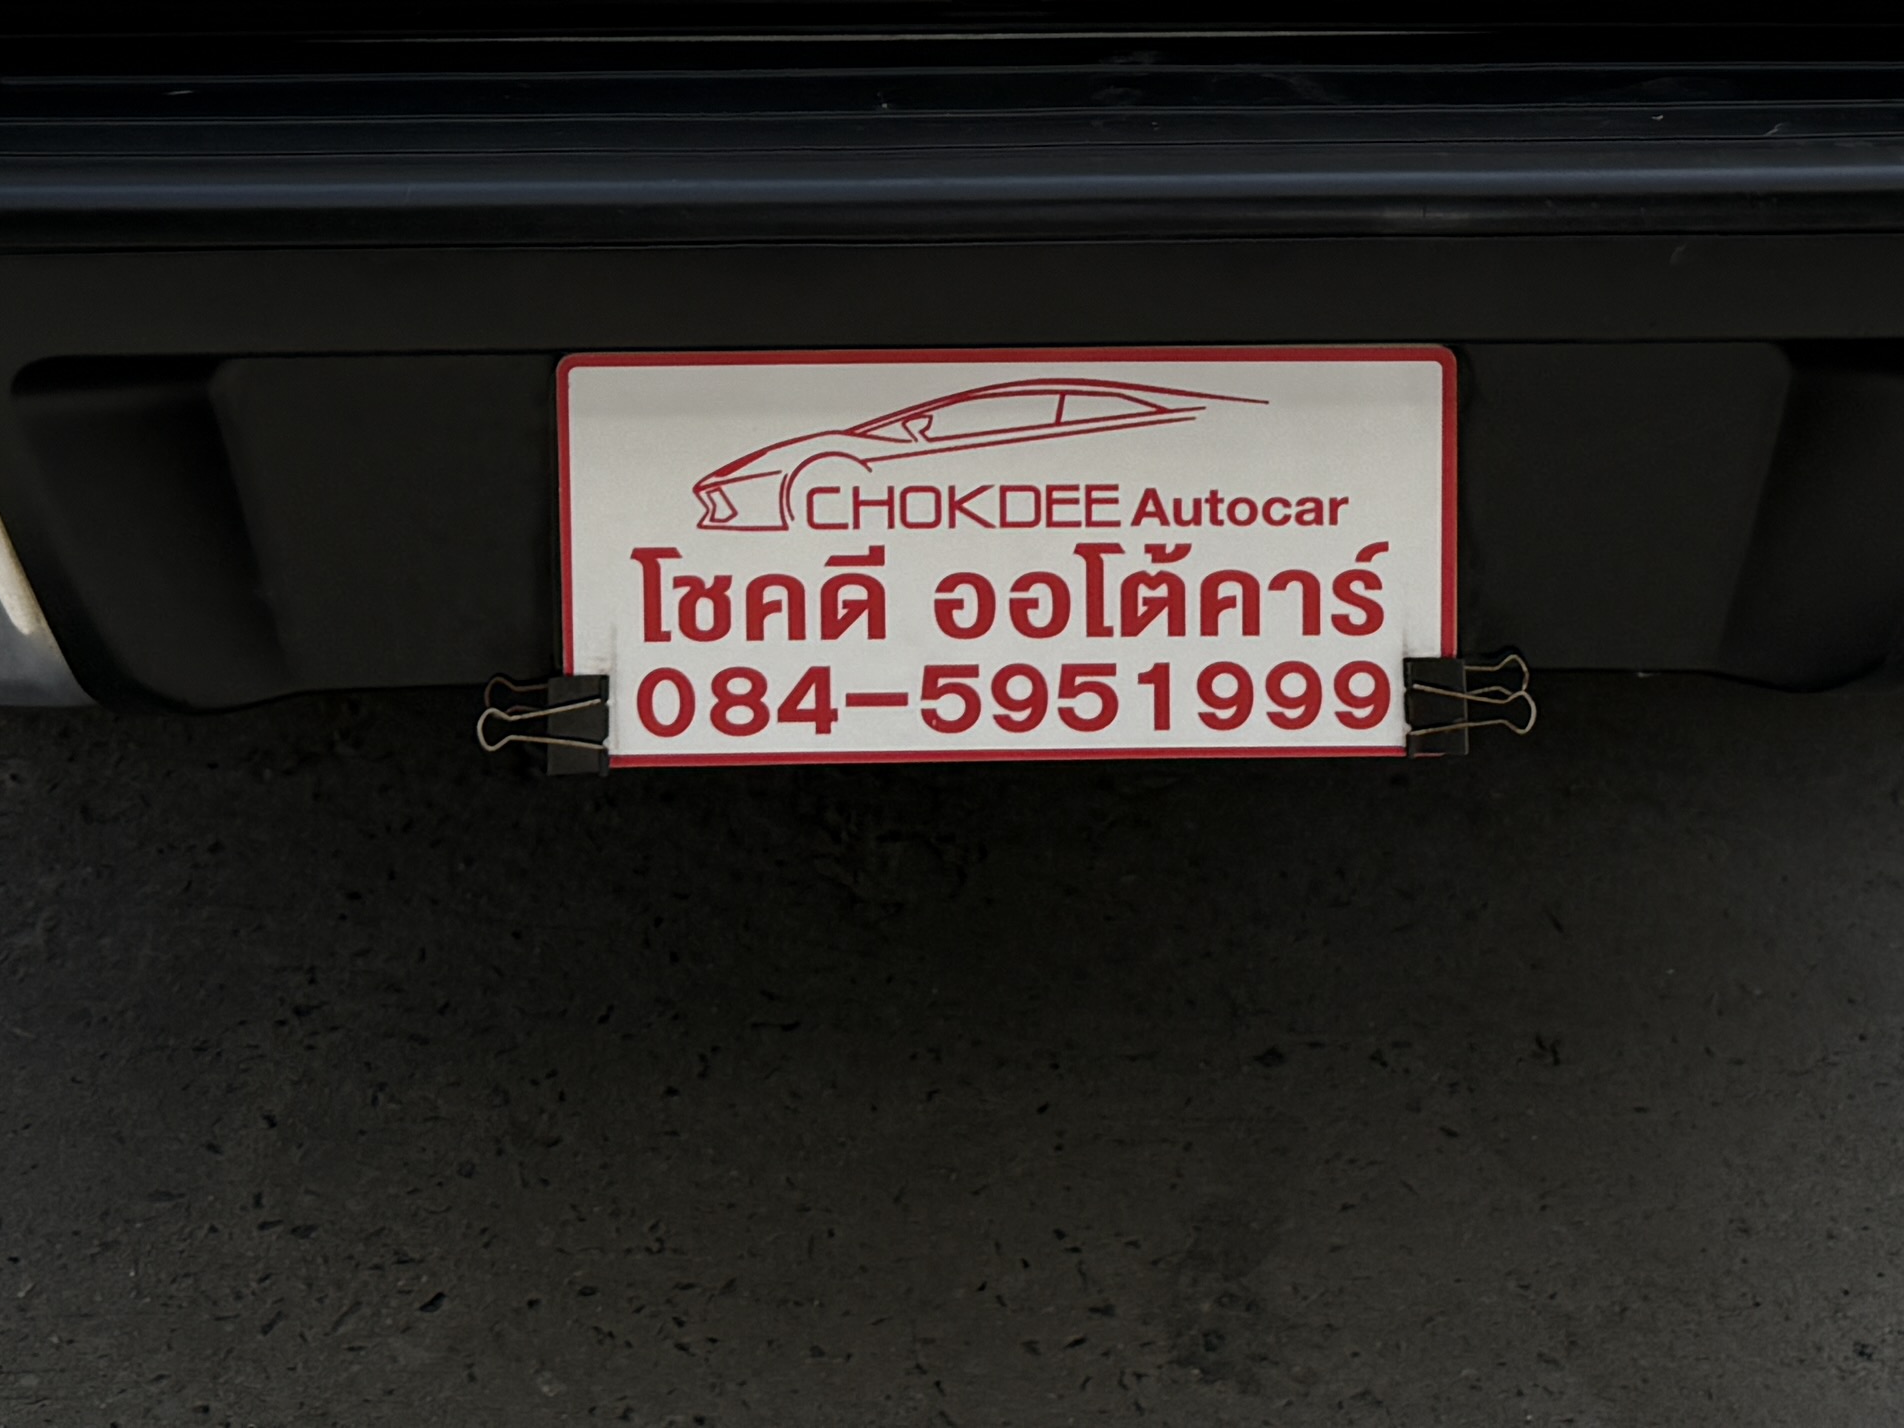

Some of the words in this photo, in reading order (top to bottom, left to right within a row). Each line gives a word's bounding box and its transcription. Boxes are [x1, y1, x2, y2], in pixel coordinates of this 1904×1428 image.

[805, 483, 1121, 531] CHOKDEE
[1131, 488, 1350, 528] Autocar
[630, 544, 887, 643] โชคดี
[933, 540, 1390, 640] ออโต้คาร์
[634, 659, 1392, 737] 084-5951999
